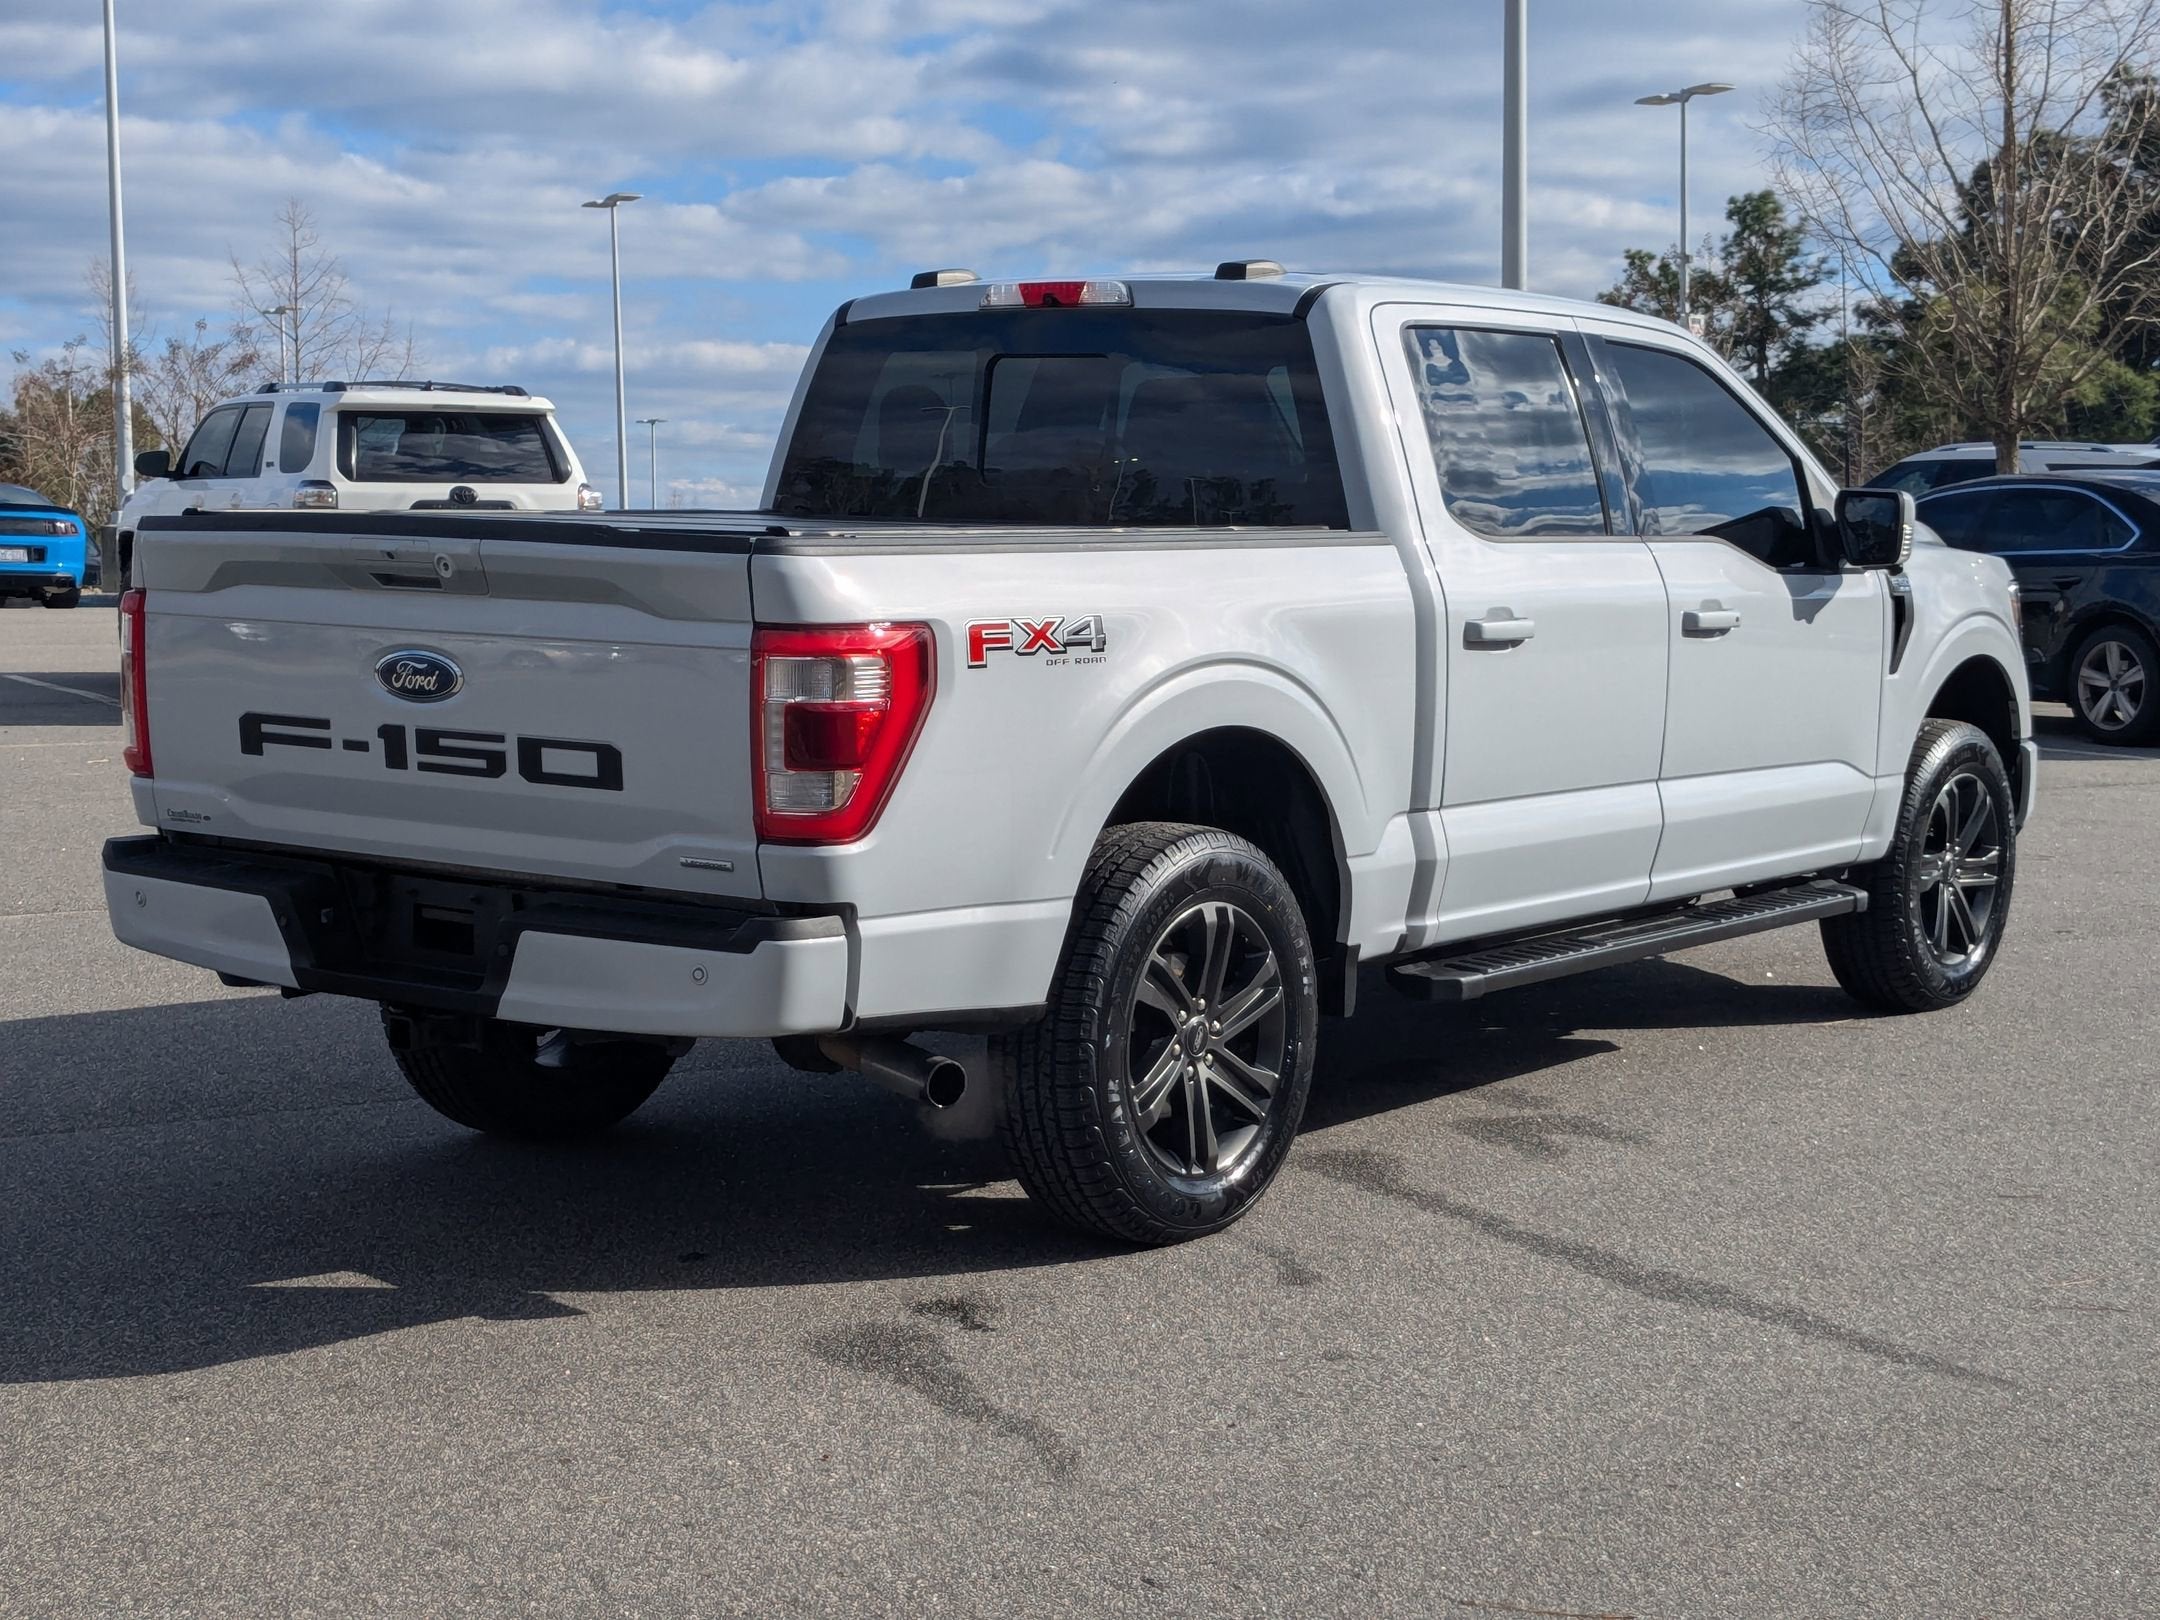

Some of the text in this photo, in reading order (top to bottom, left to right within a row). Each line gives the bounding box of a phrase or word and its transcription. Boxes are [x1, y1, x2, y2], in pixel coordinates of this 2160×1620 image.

[965, 614, 1106, 669] FX4
[1046, 656, 1107, 666] OFF ROAD
[391, 660, 440, 691] Ford
[239, 711, 624, 791] F-150
